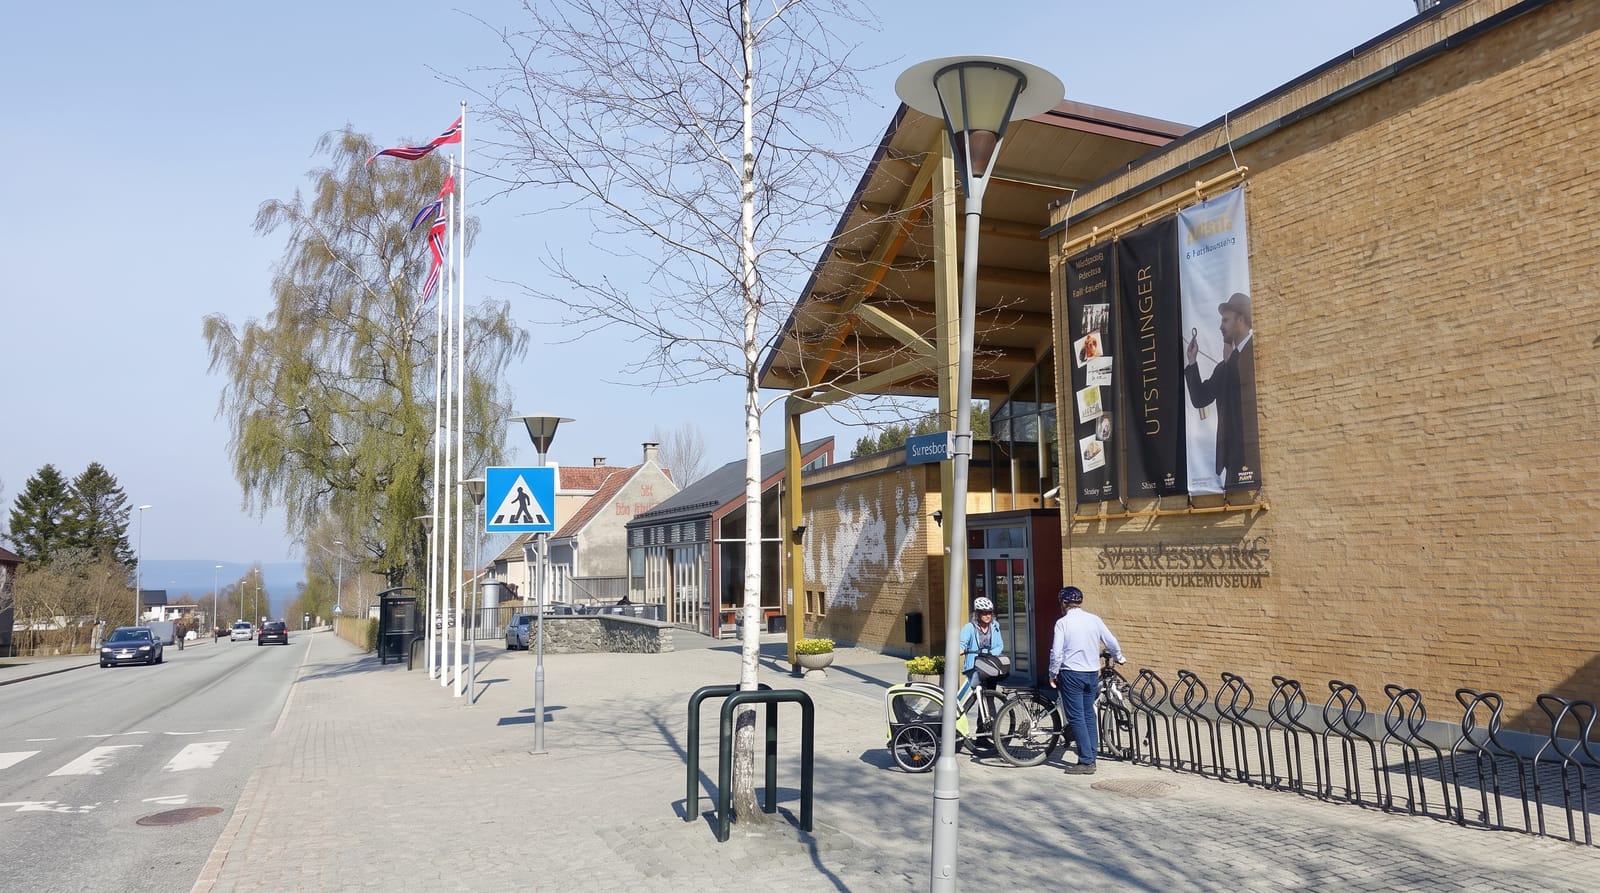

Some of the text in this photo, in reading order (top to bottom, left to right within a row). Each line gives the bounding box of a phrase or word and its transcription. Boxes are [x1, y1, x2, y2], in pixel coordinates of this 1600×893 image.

[1137, 265, 1161, 436] UTSTILLINGER
[1099, 574, 1263, 588] TRØNDELAG FOLKEMUSEUM
